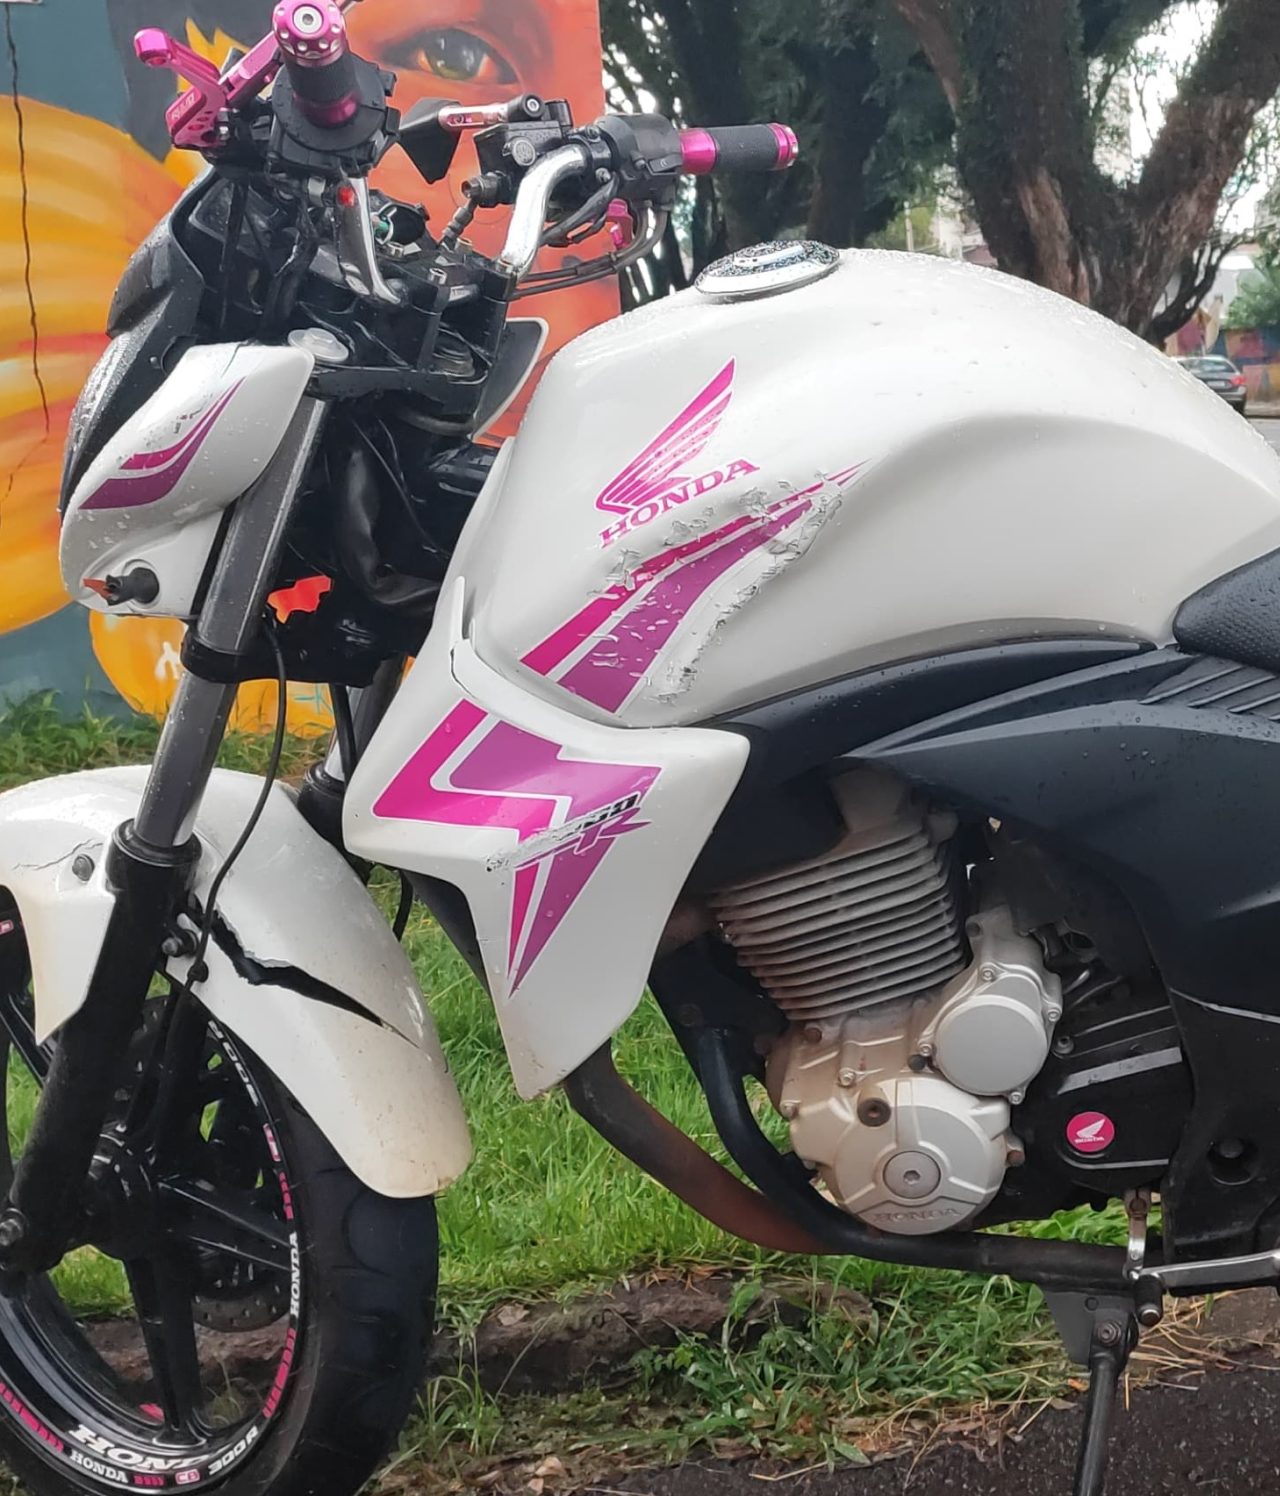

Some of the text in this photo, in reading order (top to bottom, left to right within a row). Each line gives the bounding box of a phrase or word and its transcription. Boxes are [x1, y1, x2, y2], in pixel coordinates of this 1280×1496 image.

[599, 458, 761, 549] HONDA
[289, 1231, 301, 1319] HONDA
[69, 1448, 129, 1484] HONDA
[175, 1425, 259, 1485] CB 300R
